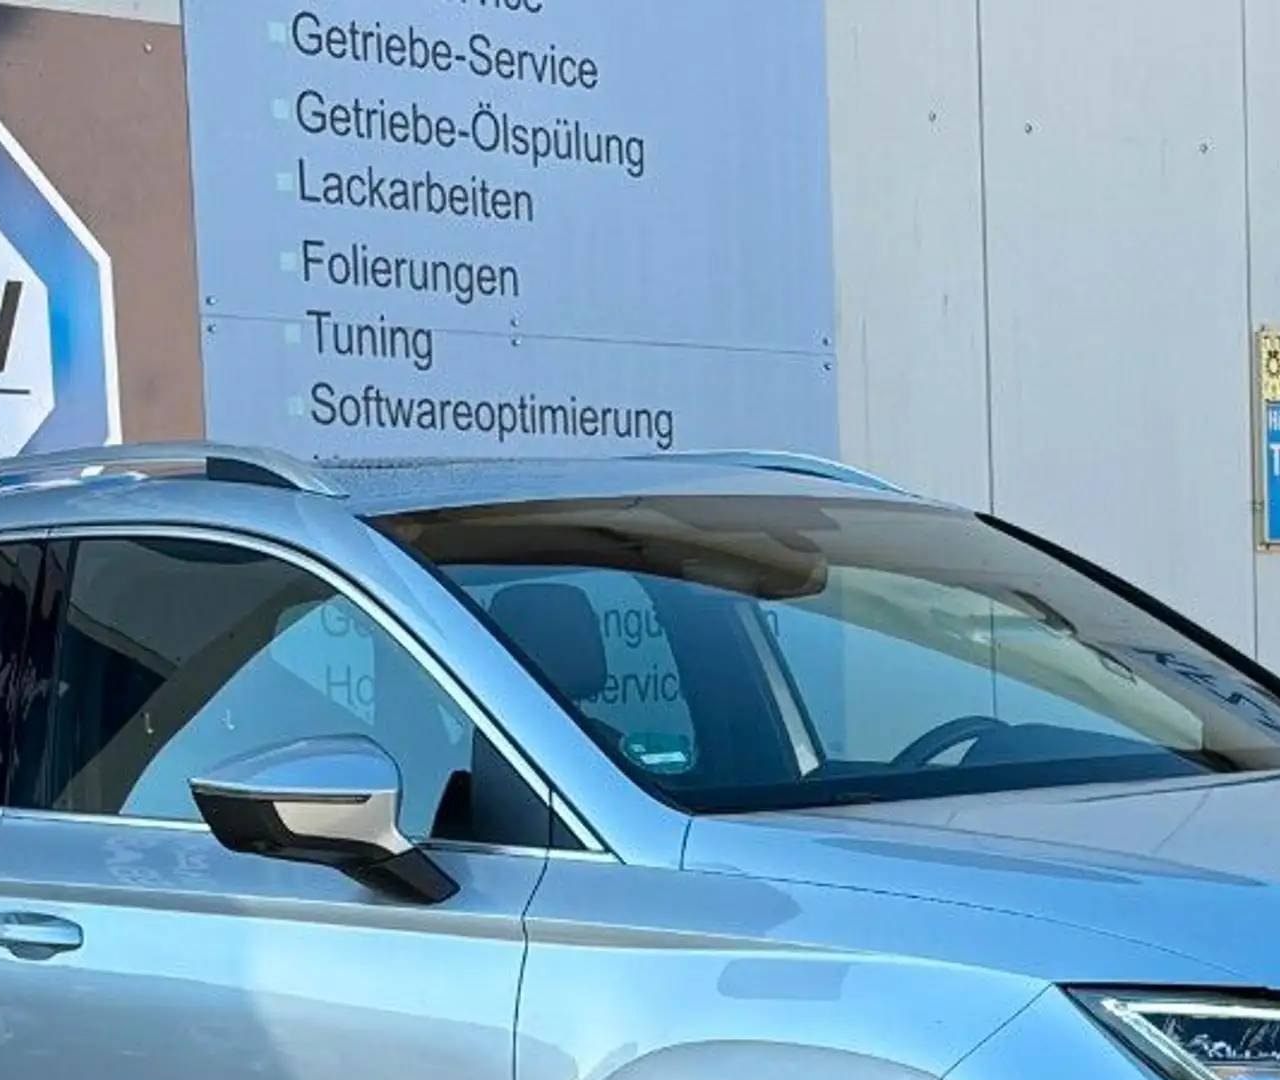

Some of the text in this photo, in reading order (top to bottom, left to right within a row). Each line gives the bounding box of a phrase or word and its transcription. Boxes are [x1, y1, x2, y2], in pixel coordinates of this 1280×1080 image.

[292, 12, 599, 90] Getriebe-Service
[295, 90, 645, 178] Getriebe-Ölspülung
[298, 159, 534, 221] Lackarbeiten
[301, 240, 520, 304] Folierungen
[306, 310, 433, 370] Tuning
[310, 383, 674, 448] Softwareoptimierung
